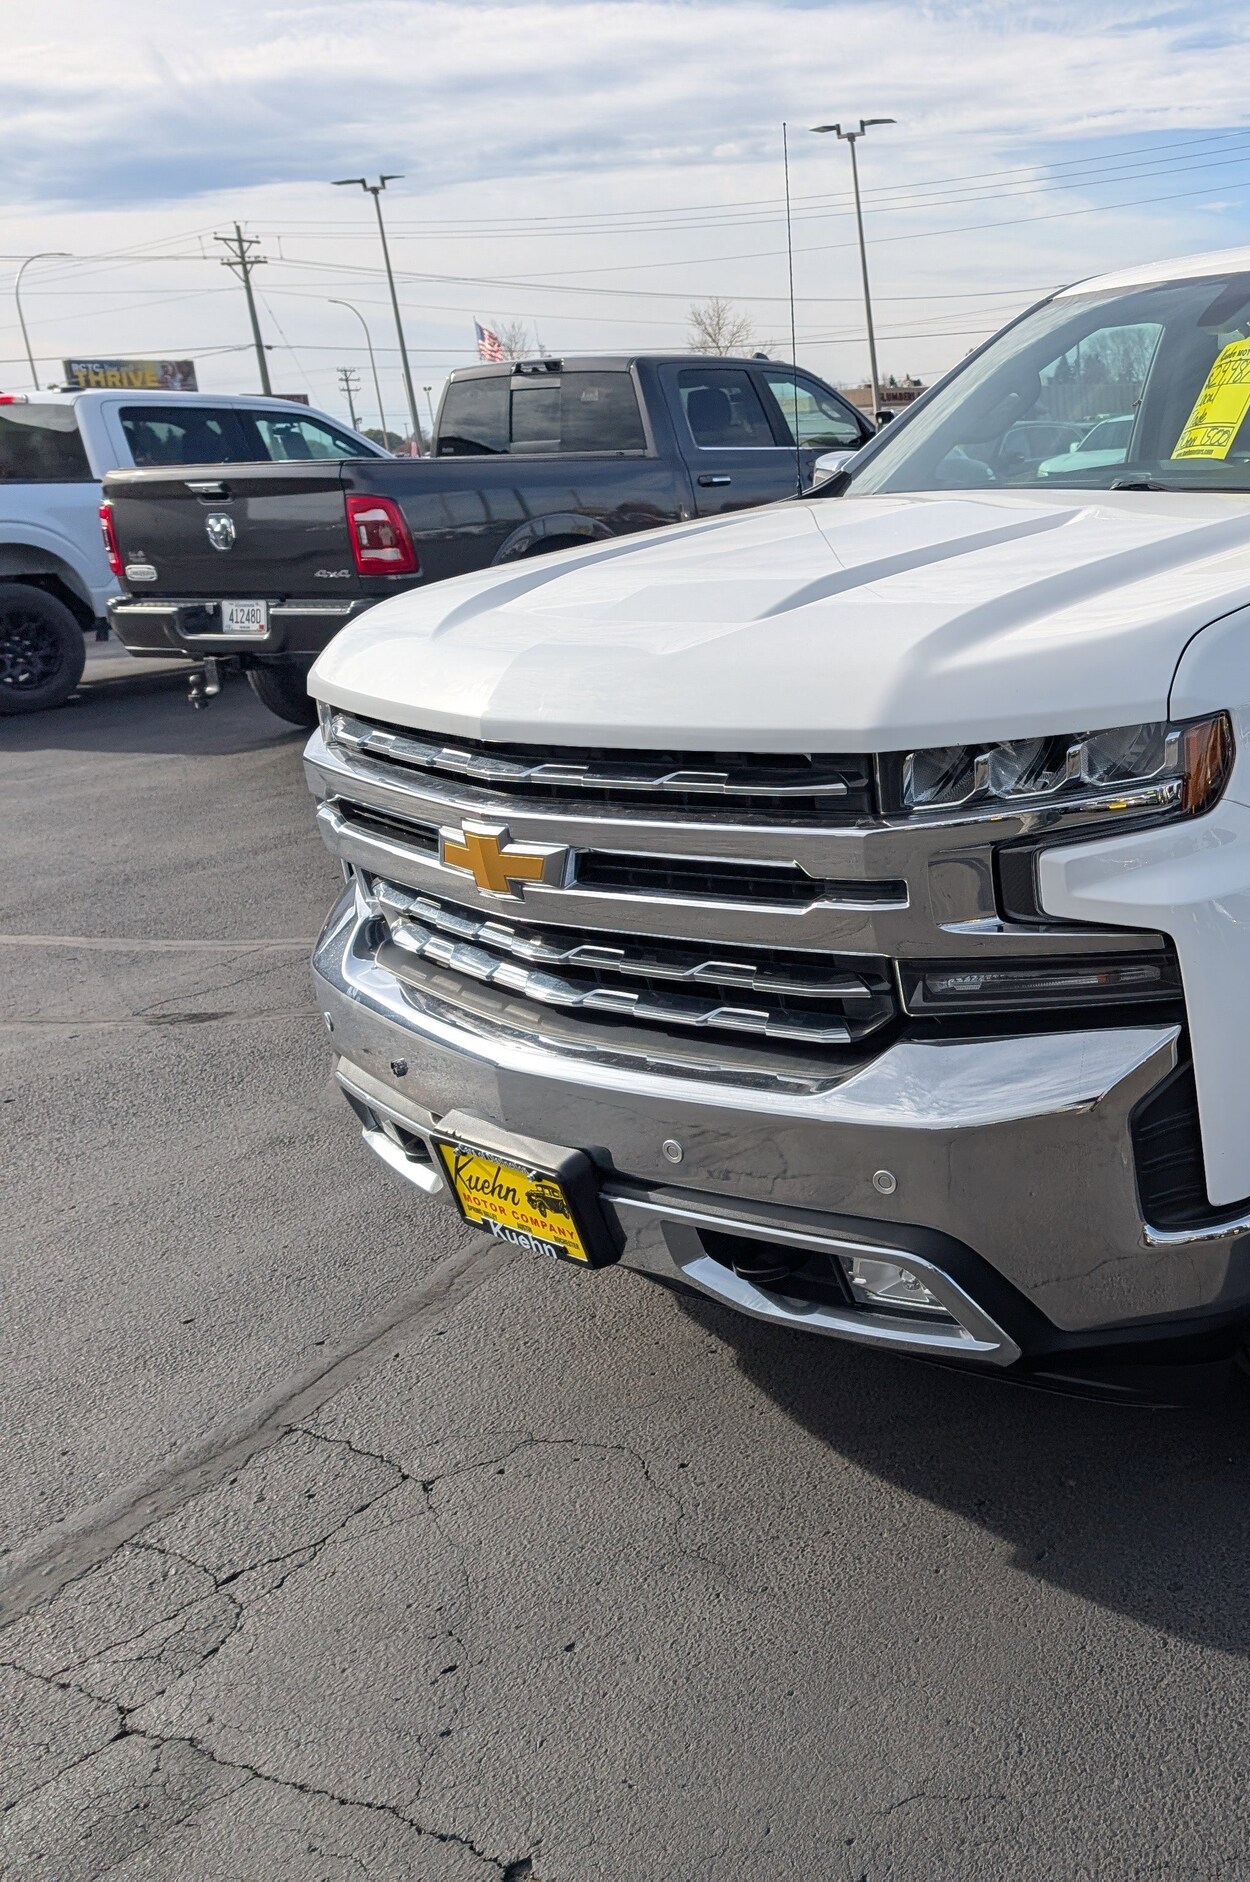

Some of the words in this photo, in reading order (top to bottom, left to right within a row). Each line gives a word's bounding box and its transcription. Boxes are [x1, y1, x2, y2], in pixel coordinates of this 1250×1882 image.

[74, 369, 160, 387] THRIVE
[1201, 427, 1231, 445] 1500
[453, 1154, 520, 1206] Kuehn
[463, 1193, 507, 1216] MOTOR
[512, 1210, 576, 1240] COMPANY
[489, 1220, 557, 1259] Kuehn
